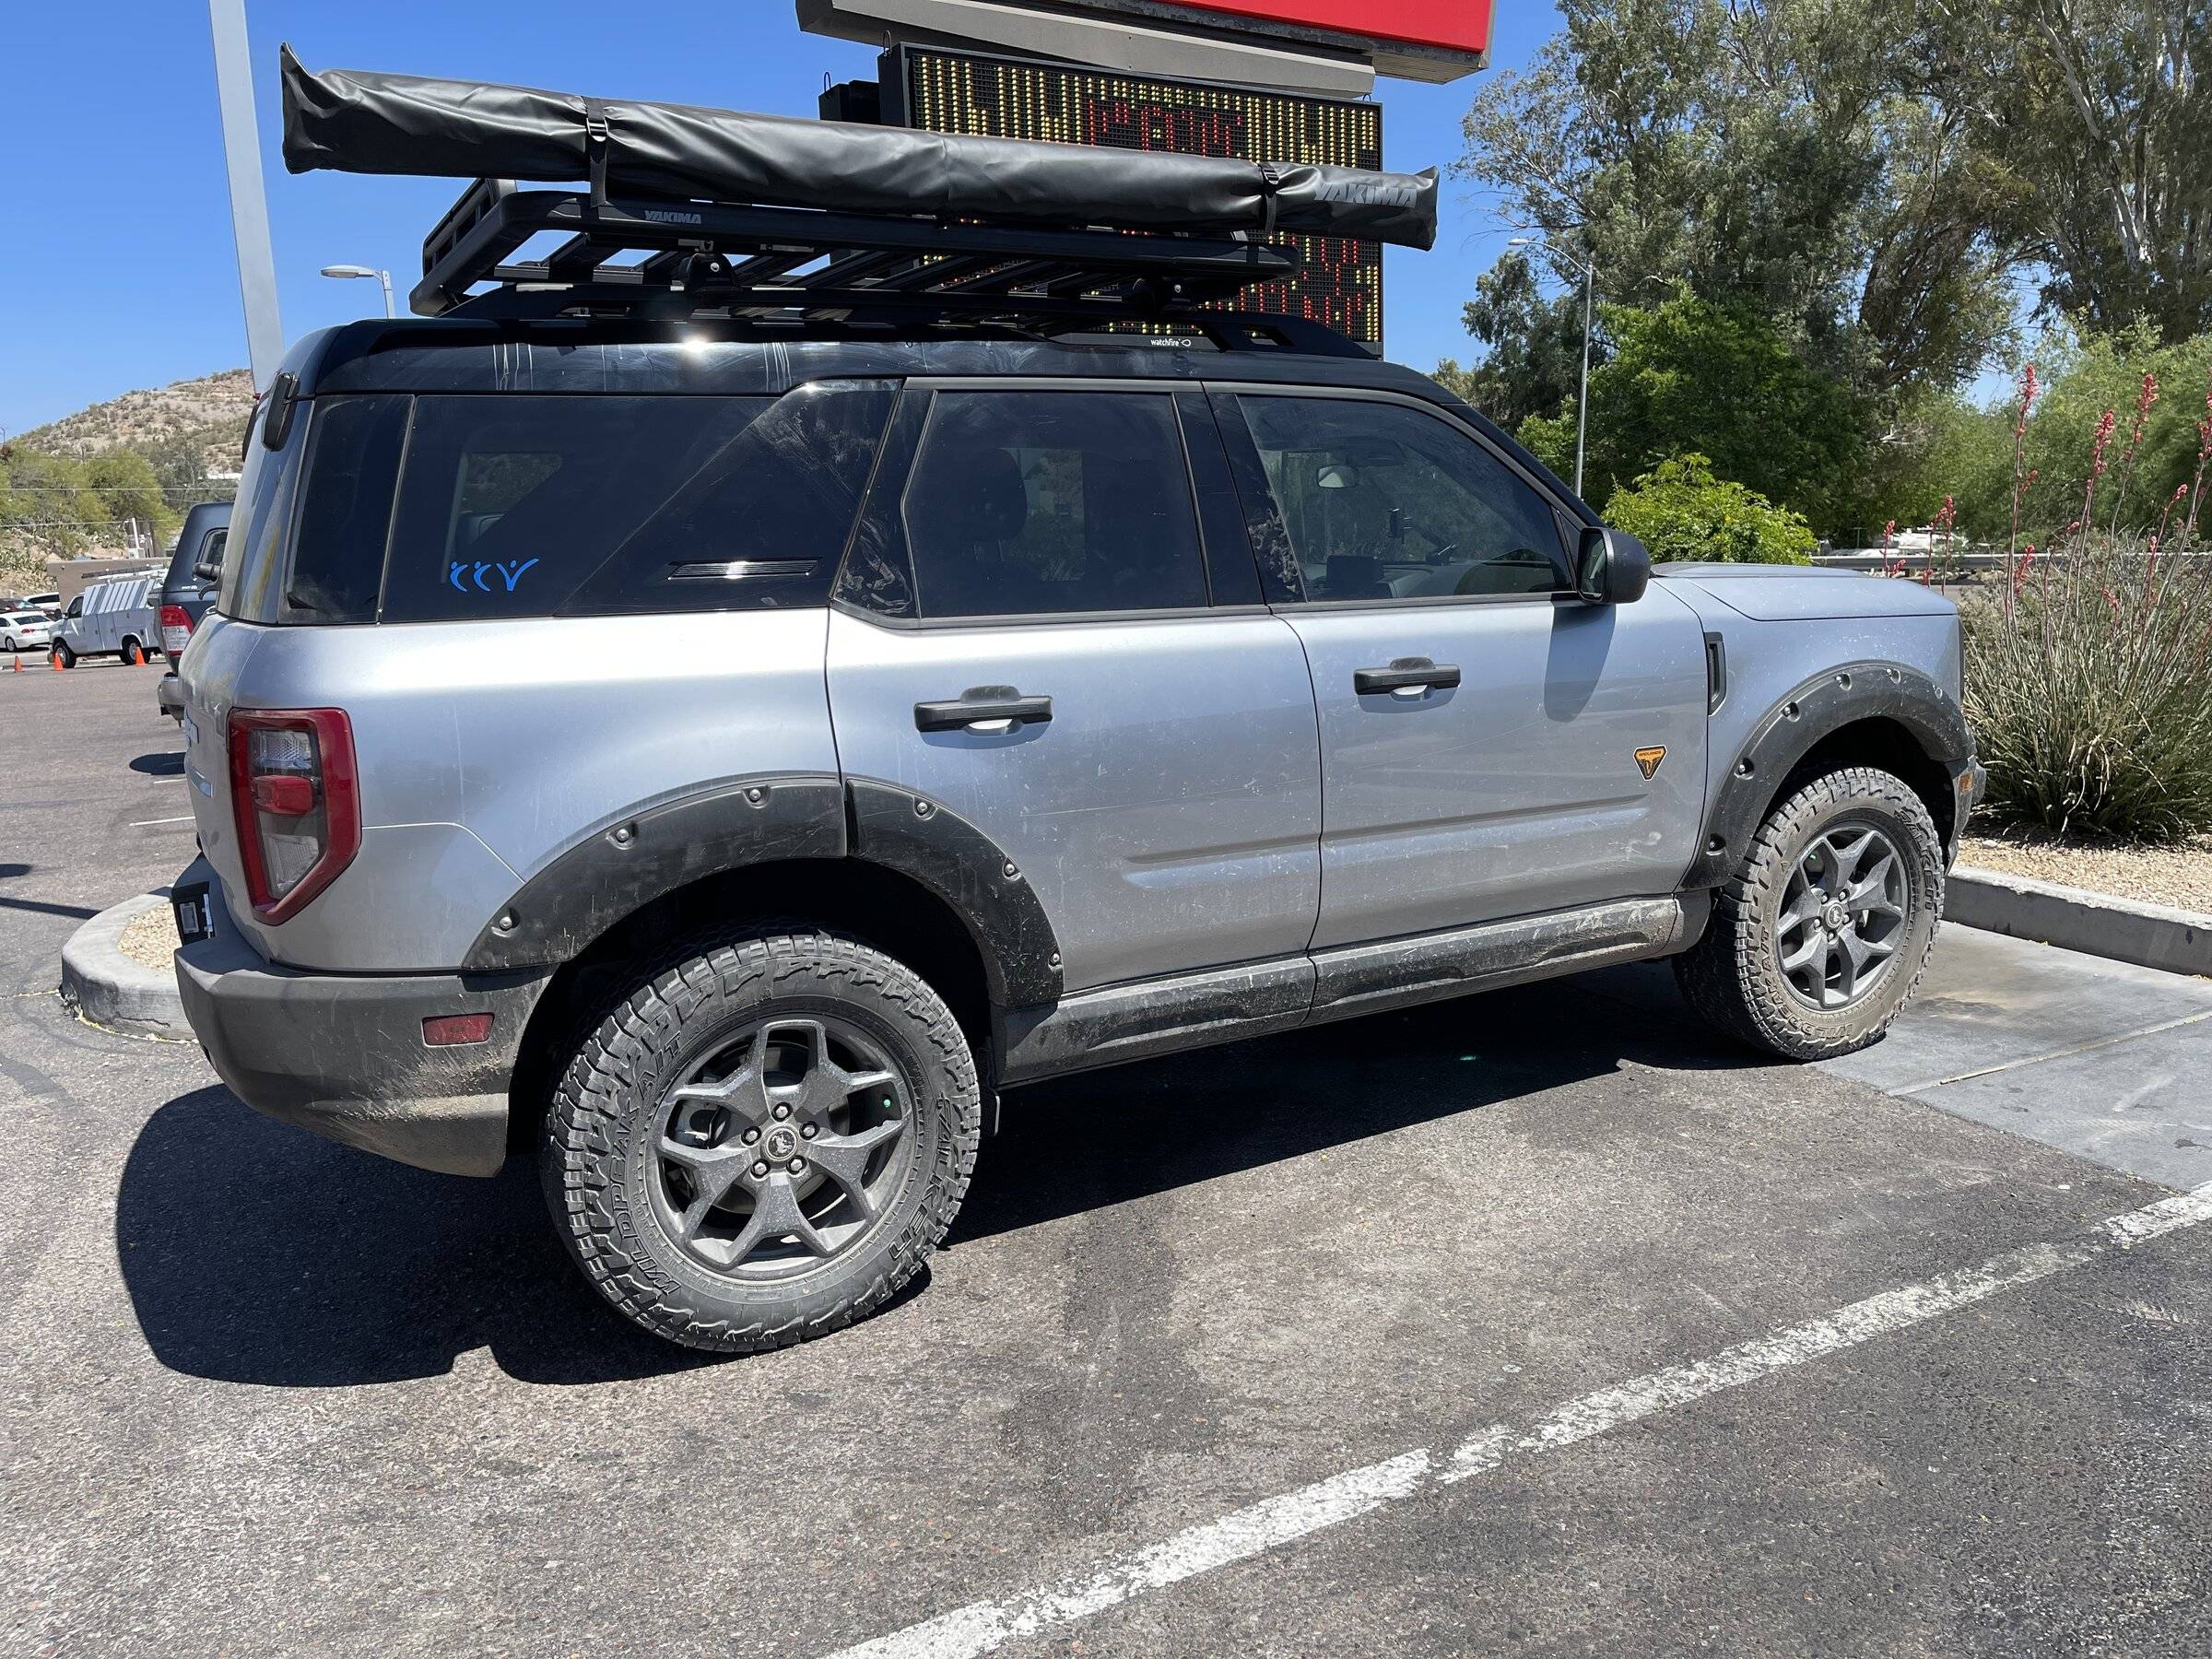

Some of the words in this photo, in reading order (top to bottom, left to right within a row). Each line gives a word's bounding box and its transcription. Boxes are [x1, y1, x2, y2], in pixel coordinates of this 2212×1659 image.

[1313, 183, 1418, 208] YAKIMA
[644, 210, 701, 224] YAKIMA
[609, 1097, 682, 1296] WILDPEAK
